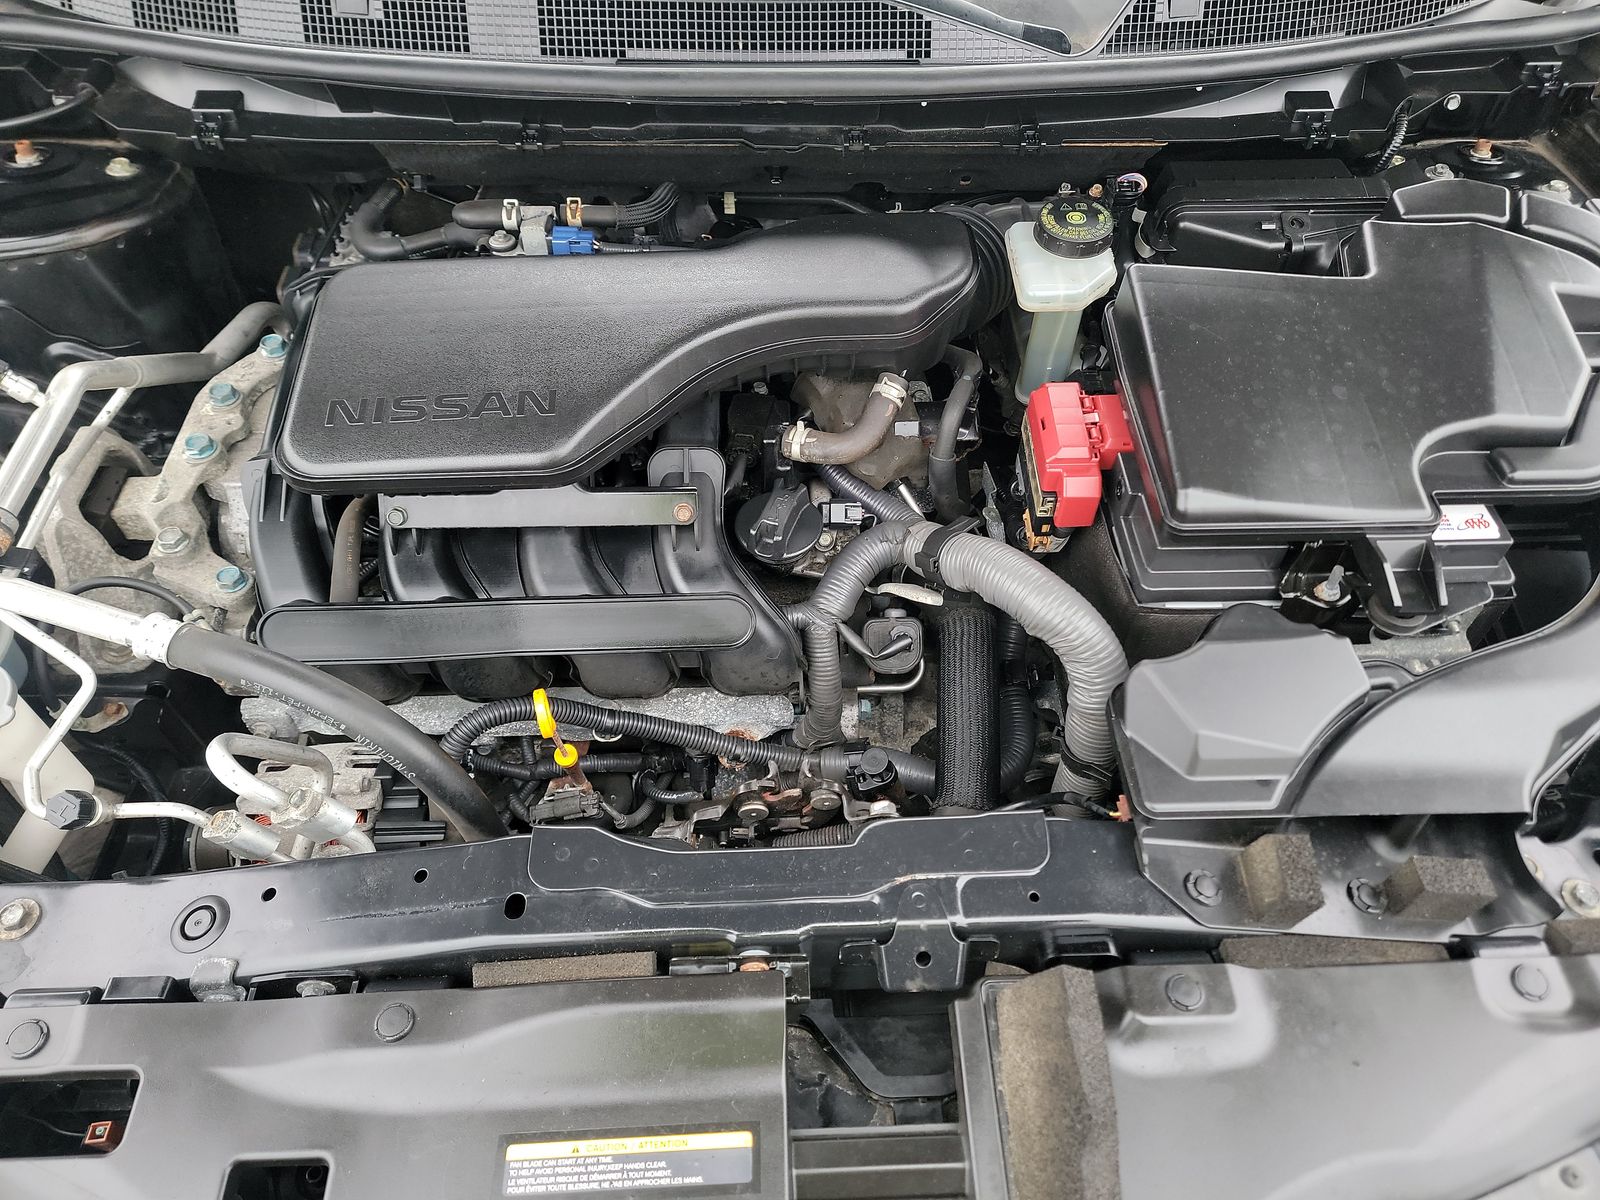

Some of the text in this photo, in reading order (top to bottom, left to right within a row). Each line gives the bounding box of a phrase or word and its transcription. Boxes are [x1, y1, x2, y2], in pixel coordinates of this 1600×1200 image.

[325, 389, 557, 427] NISSAN
[586, 1142, 627, 1152] CAUTION
[638, 1138, 688, 1148] ATTENTION
[535, 1167, 553, 1175] AVOID
[554, 1165, 586, 1174] PERSONAL
[624, 1162, 644, 1170] HANDS
[517, 1176, 555, 1185] VENTILATEUR
[556, 1175, 578, 1183] RISQUE
[633, 1178, 670, 1186] APPROCHER
